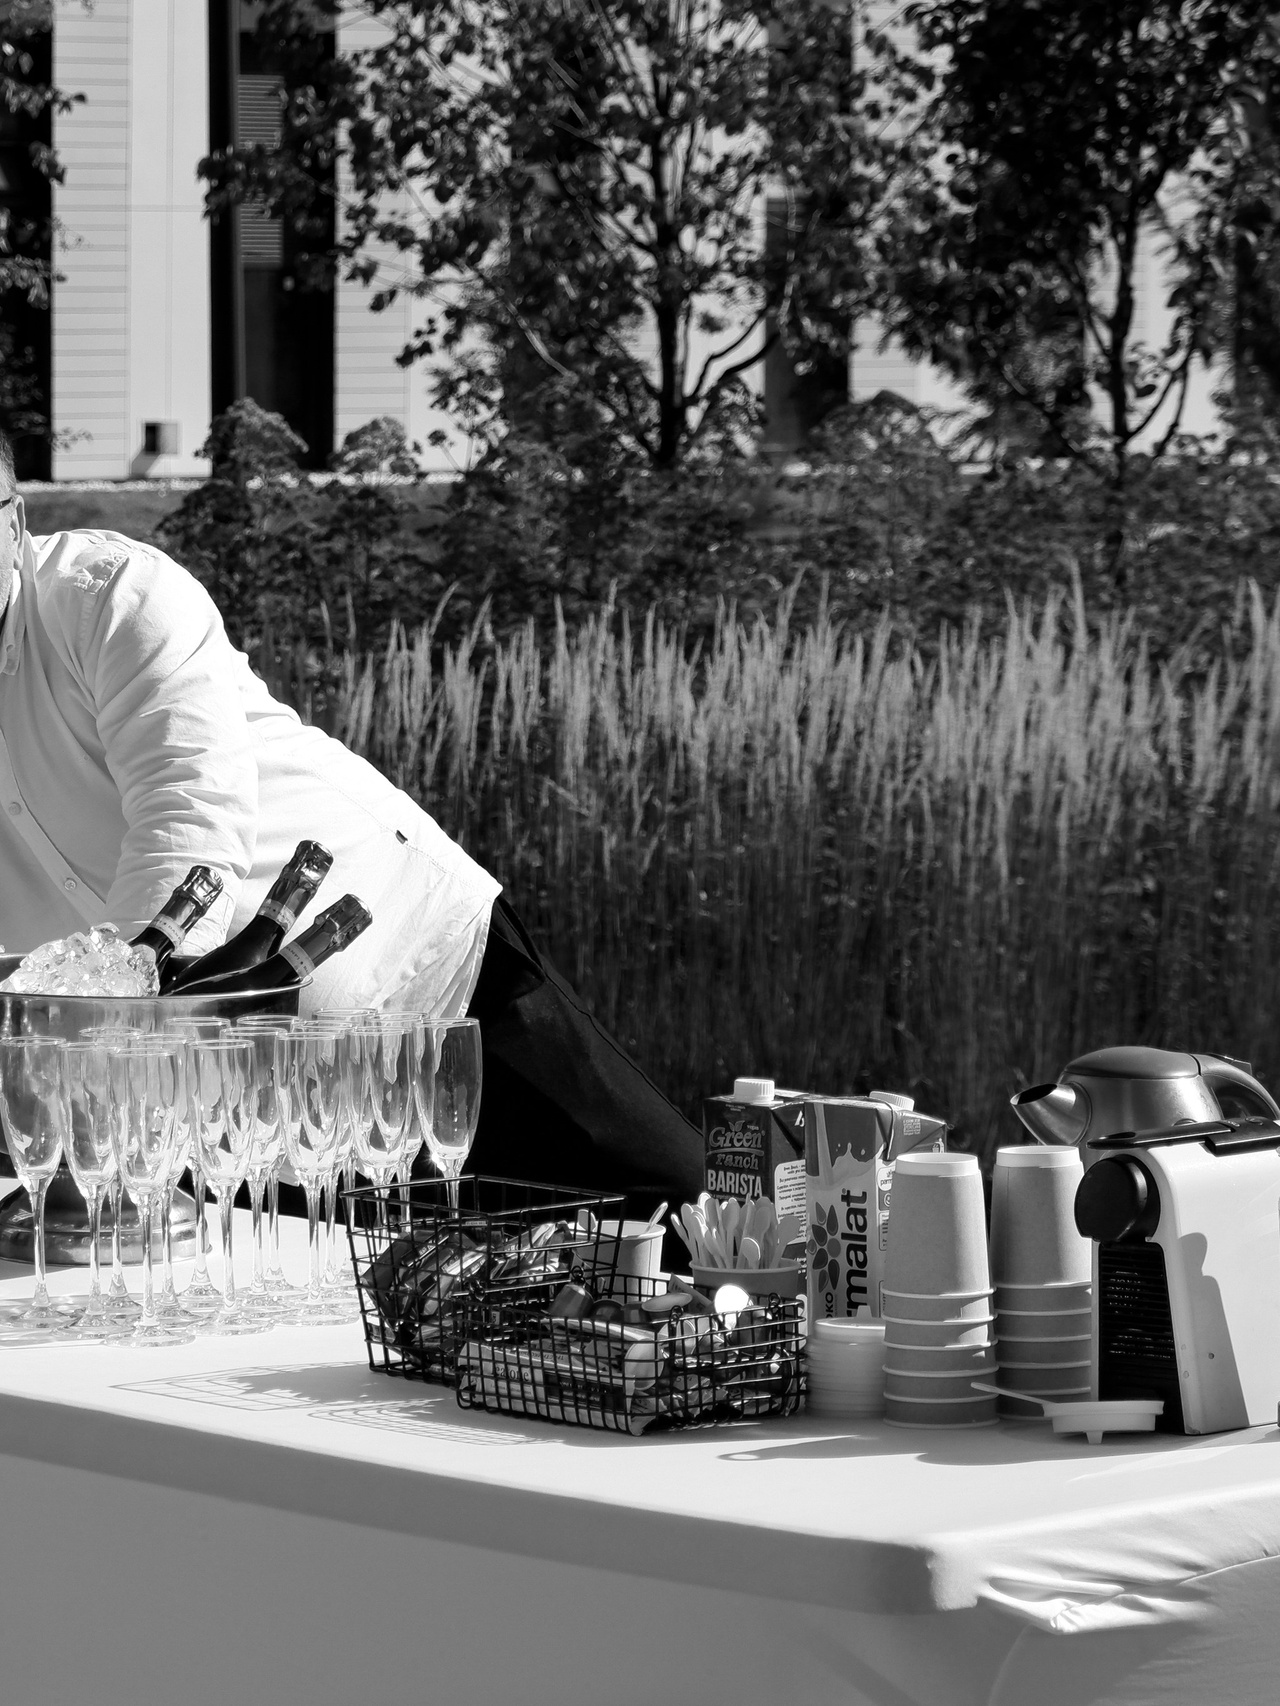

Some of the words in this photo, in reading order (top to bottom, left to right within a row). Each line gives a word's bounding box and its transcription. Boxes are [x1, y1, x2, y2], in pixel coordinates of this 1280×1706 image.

[709, 1126, 762, 1148] Green
[715, 1153, 759, 1170] ranch
[707, 1169, 763, 1198] BARISTA
[841, 1189, 868, 1317] malat
